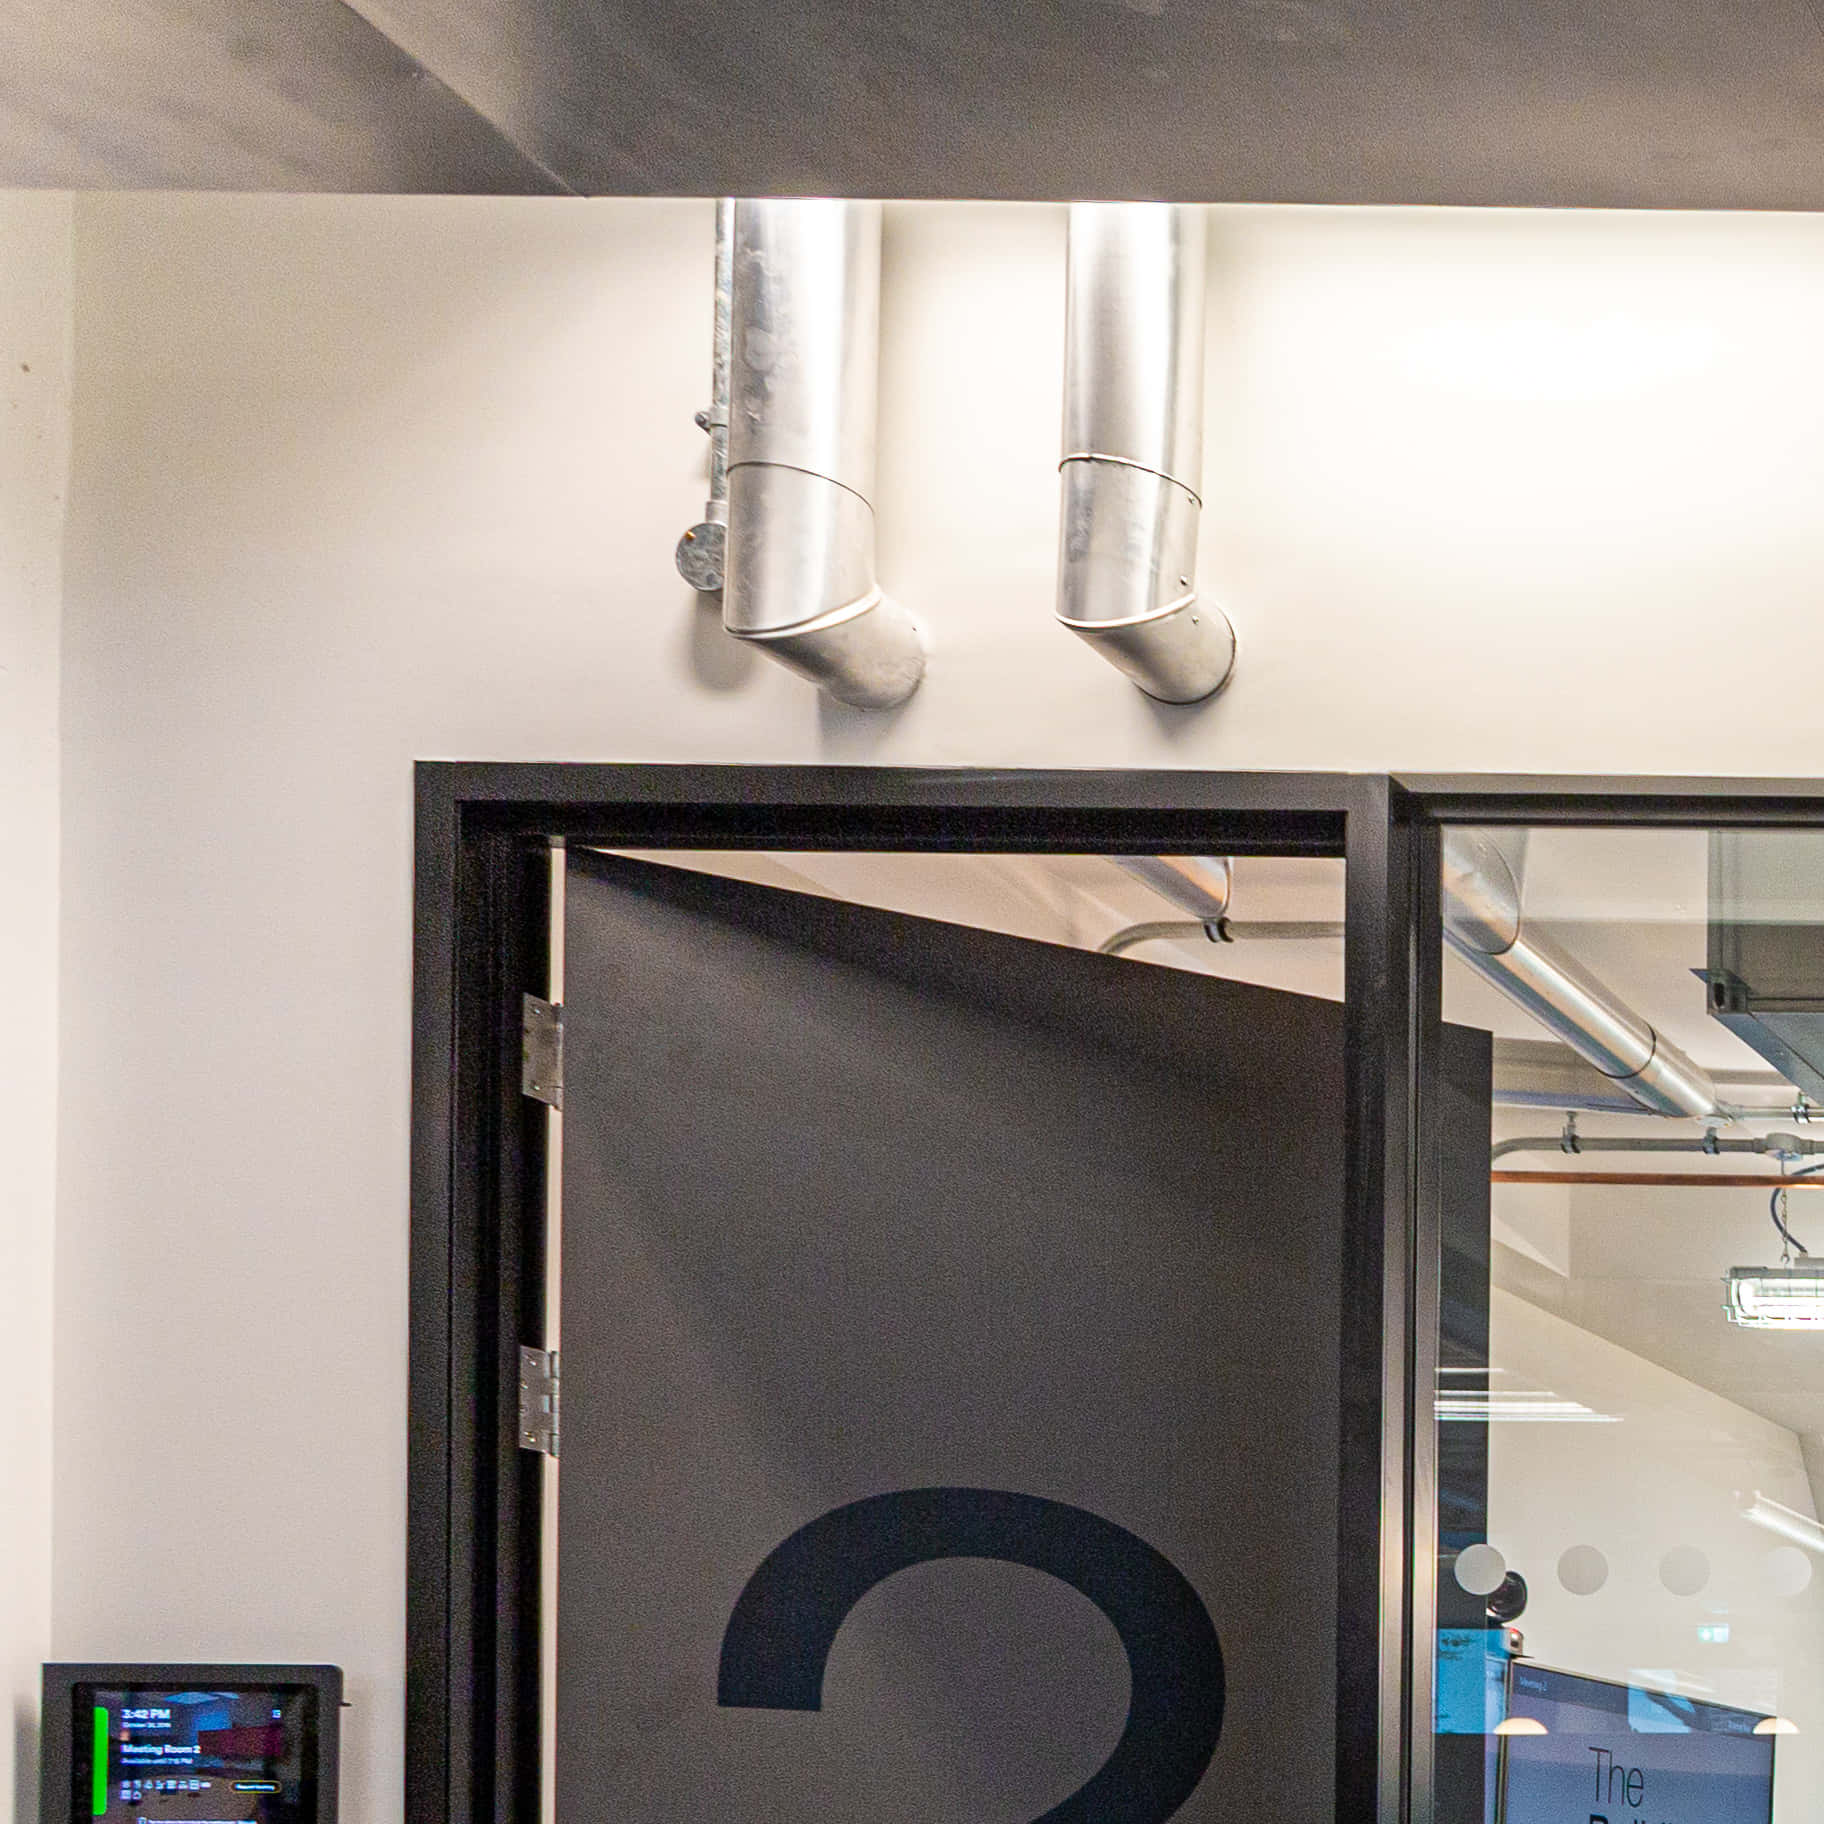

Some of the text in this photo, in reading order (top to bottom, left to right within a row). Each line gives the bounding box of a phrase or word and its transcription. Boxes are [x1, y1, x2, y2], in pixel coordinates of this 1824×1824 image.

[150, 1708, 171, 1719] PM
[121, 1744, 201, 1755] Meeting Room 2
[1588, 1746, 1645, 1808] The
